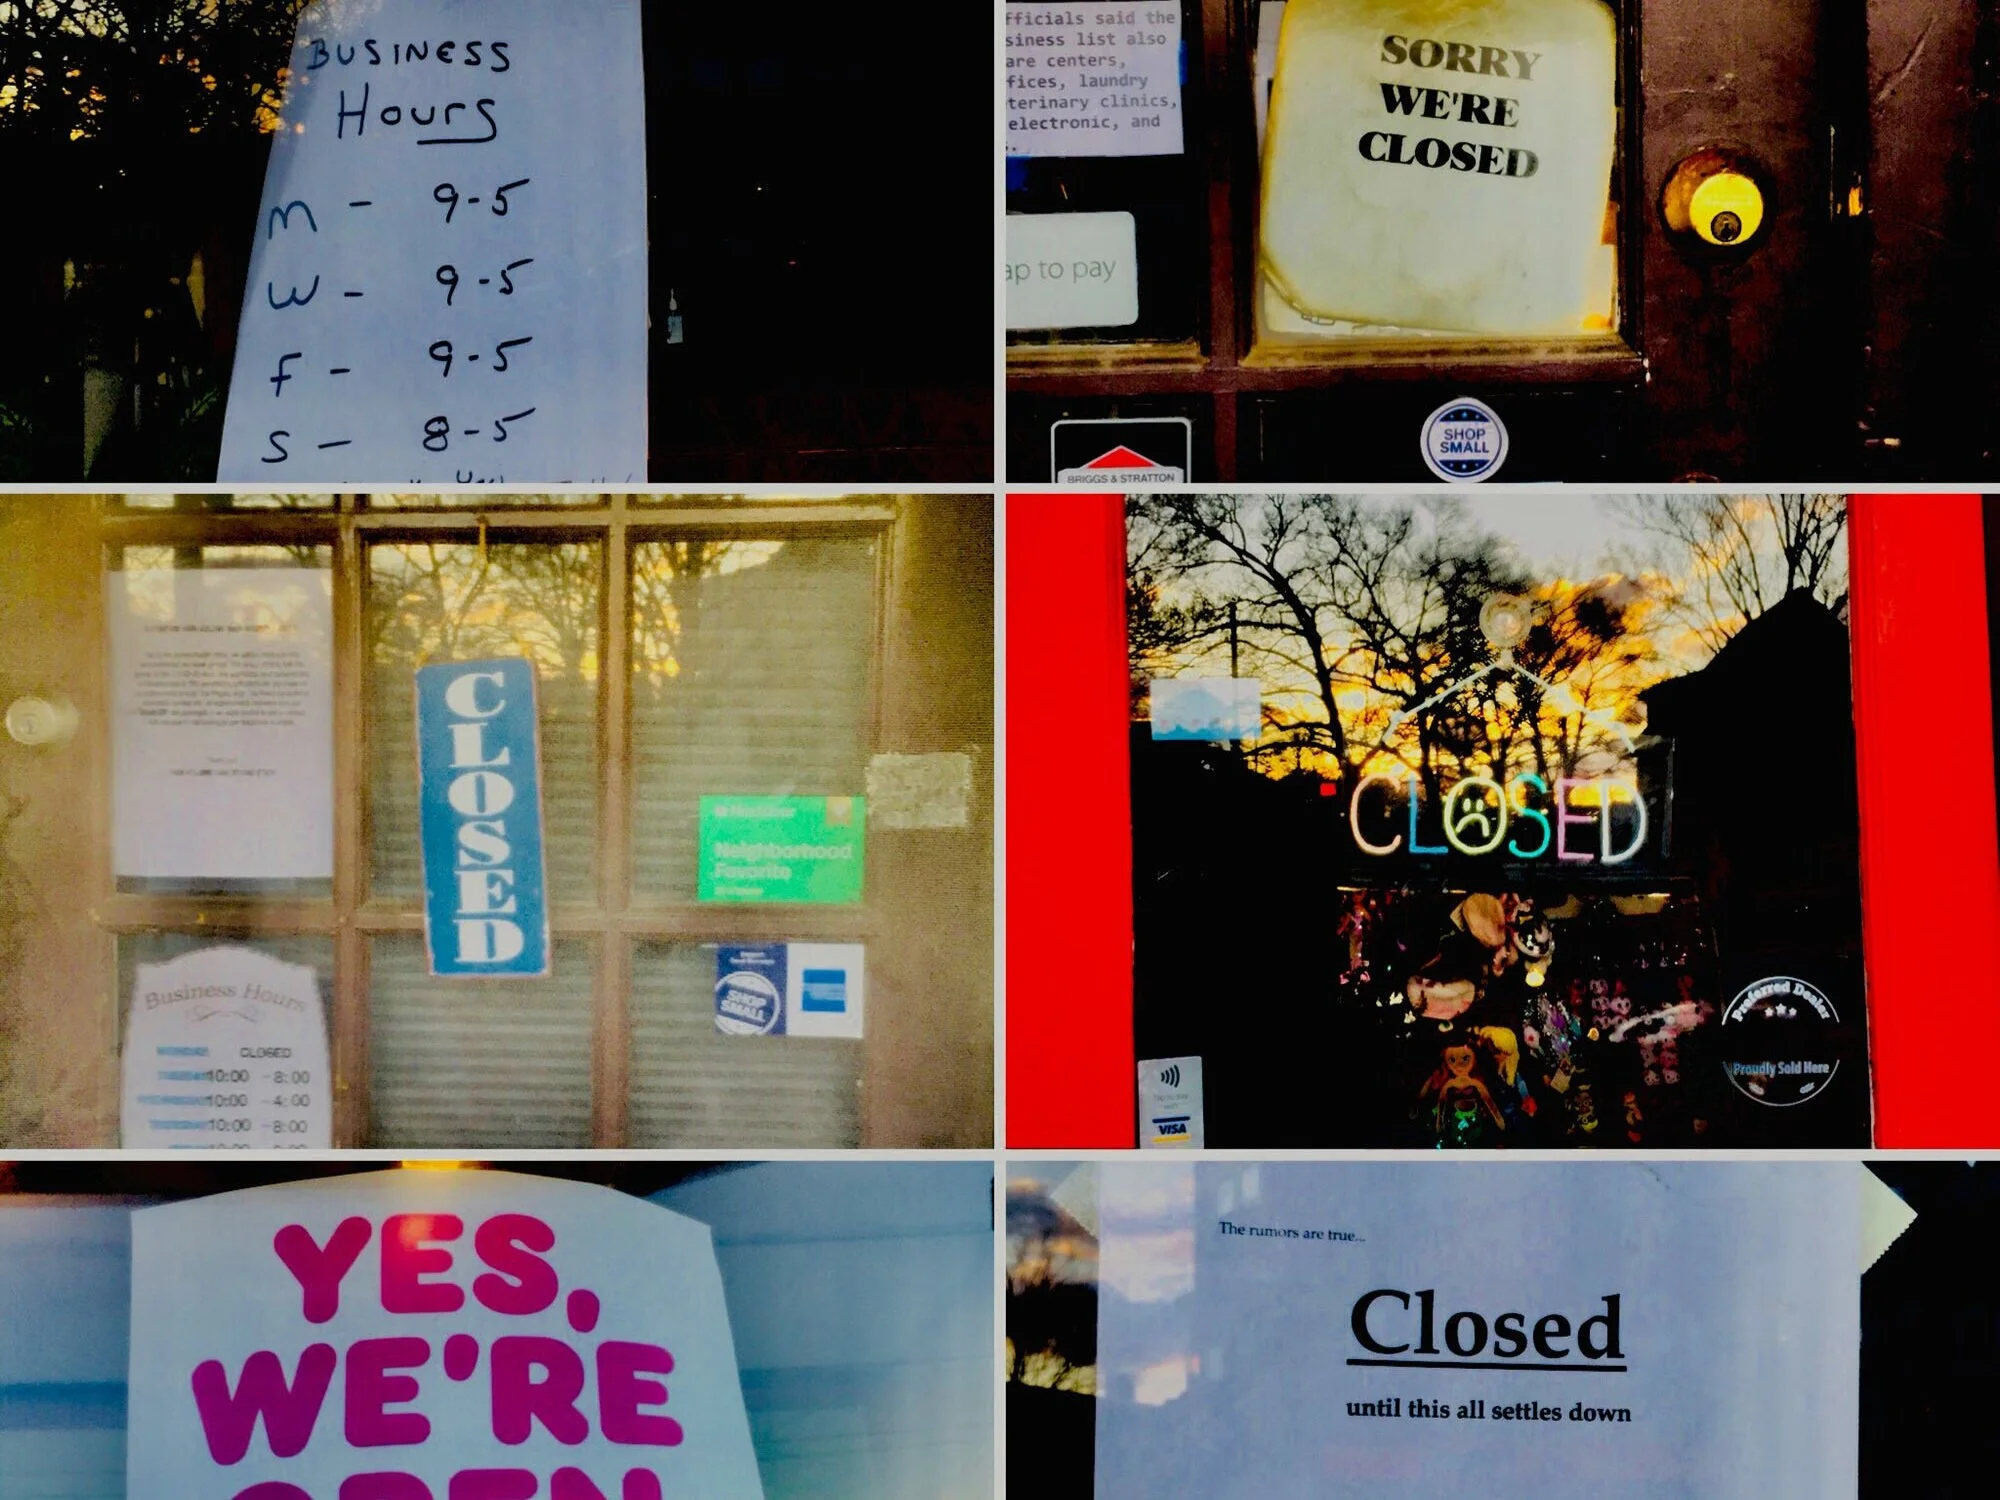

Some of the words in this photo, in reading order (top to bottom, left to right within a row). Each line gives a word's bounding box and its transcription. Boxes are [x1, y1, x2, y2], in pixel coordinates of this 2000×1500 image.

[1095, 11, 1135, 25] said
[1145, 10, 1175, 25] the
[1077, 32, 1116, 46] list
[1126, 31, 1167, 46] also
[306, 38, 511, 73] BUSINESS
[1047, 55, 1126, 69] centers,
[1380, 34, 1544, 81] SORRY
[1079, 74, 1149, 90] laundry
[337, 82, 497, 145] Hours
[1100, 94, 1177, 109] clinics,
[1380, 83, 1520, 128] WE'RE
[1009, 116, 1119, 131] electronic,
[1131, 114, 1161, 128] and
[1358, 131, 1540, 178] CLOSED
[1038, 260, 1065, 280] to
[1072, 260, 1117, 284] pay
[1444, 427, 1486, 441] SHOP
[1440, 441, 1489, 454] SMALL
[1067, 474, 1109, 484] BRIGGS
[1110, 474, 1118, 484] &
[1119, 472, 1176, 484] STRATTON
[445, 671, 525, 964] CLOSED
[1350, 773, 1648, 866] CLOSED
[145, 982, 237, 1010] Business
[244, 981, 309, 1012] Hours
[1731, 981, 1791, 1022] Preferred
[239, 1046, 293, 1058] CLOSED
[1732, 1062, 1776, 1078] Proudly
[1778, 1061, 1801, 1075] Sold
[1803, 1061, 1830, 1074] Here
[1159, 1123, 1188, 1135] VISA
[1219, 1221, 1246, 1236] The
[1250, 1227, 1299, 1239] rumors
[1303, 1229, 1324, 1240] are
[1328, 1229, 1366, 1242] true...
[273, 1213, 602, 1333] YES,
[1349, 1289, 1626, 1361] Closed
[191, 1334, 684, 1466] WE'RE
[1346, 1398, 1402, 1418] until
[1408, 1399, 1450, 1419] this
[1456, 1400, 1485, 1419] all
[1491, 1401, 1562, 1422] settles
[1568, 1402, 1632, 1423] down
